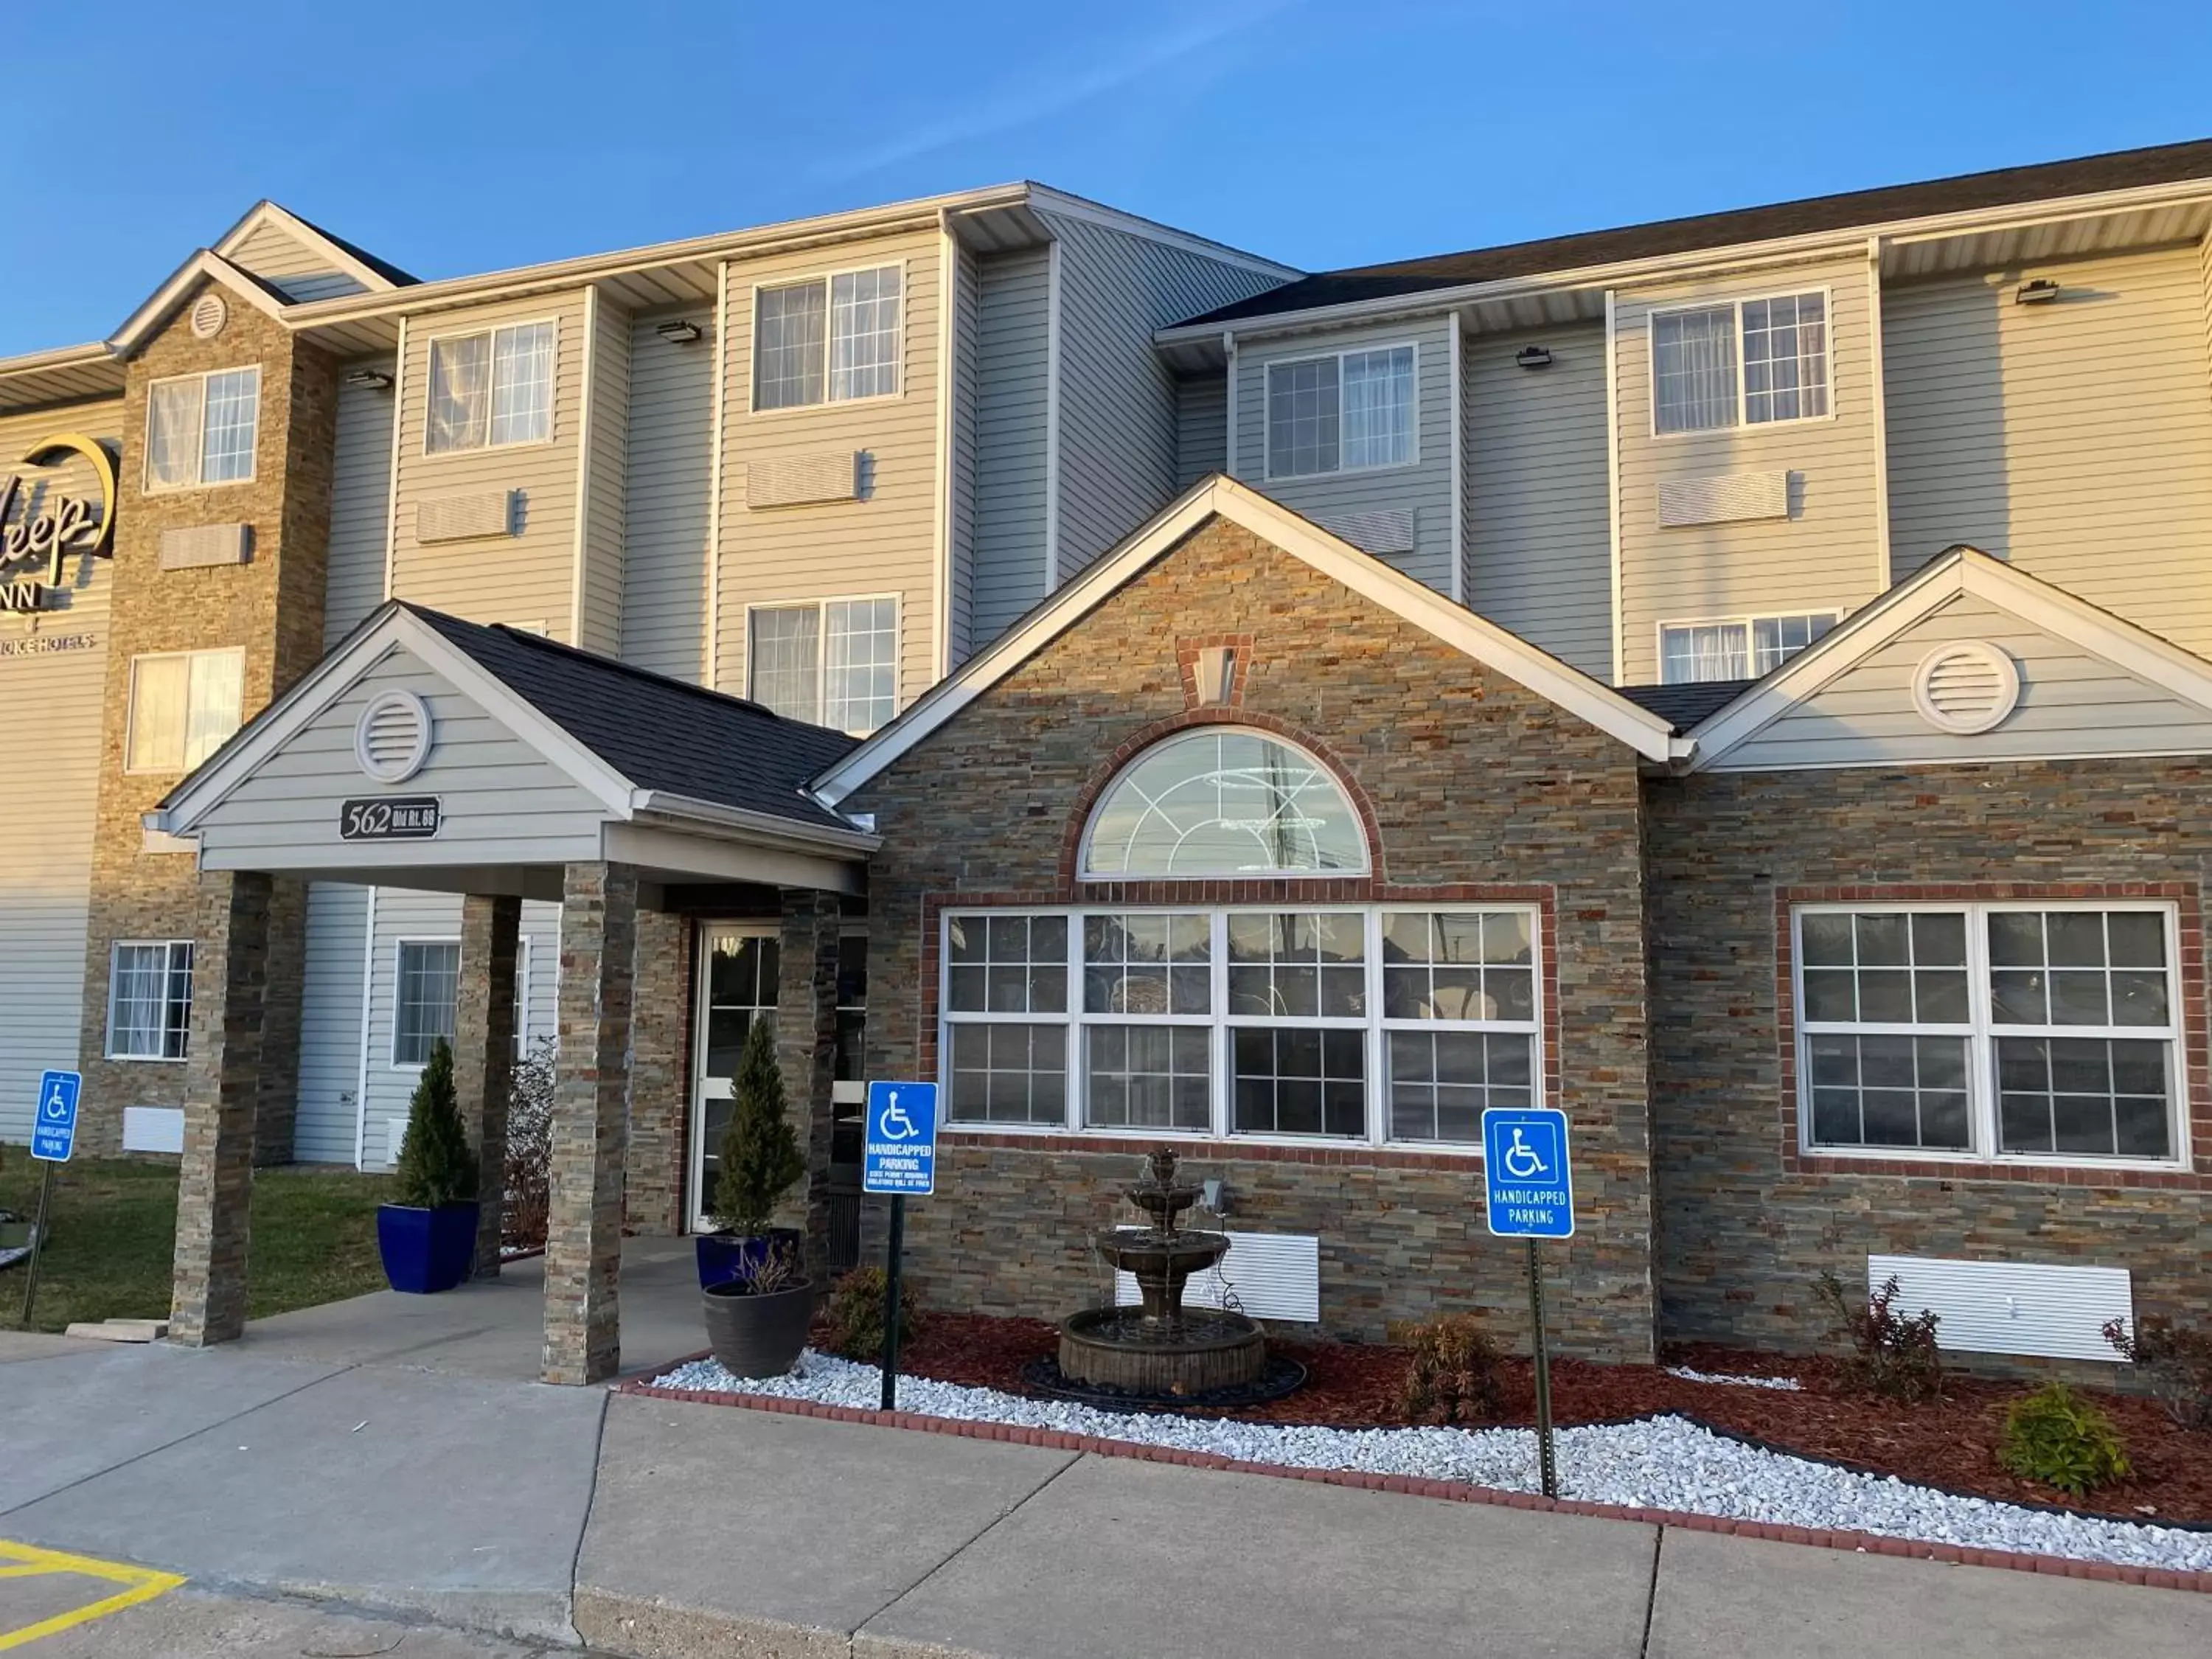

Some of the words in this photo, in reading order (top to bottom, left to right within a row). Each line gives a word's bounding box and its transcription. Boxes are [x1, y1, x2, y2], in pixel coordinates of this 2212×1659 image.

[0, 638, 36, 658] OICE
[344, 802, 392, 837] 562
[422, 809, 435, 827] 66
[868, 1144, 932, 1157] HANDICAPPED
[879, 1157, 919, 1170] PARKING
[1494, 1189, 1565, 1206] HANDICAPPED
[1508, 1208, 1554, 1224] PARKING
